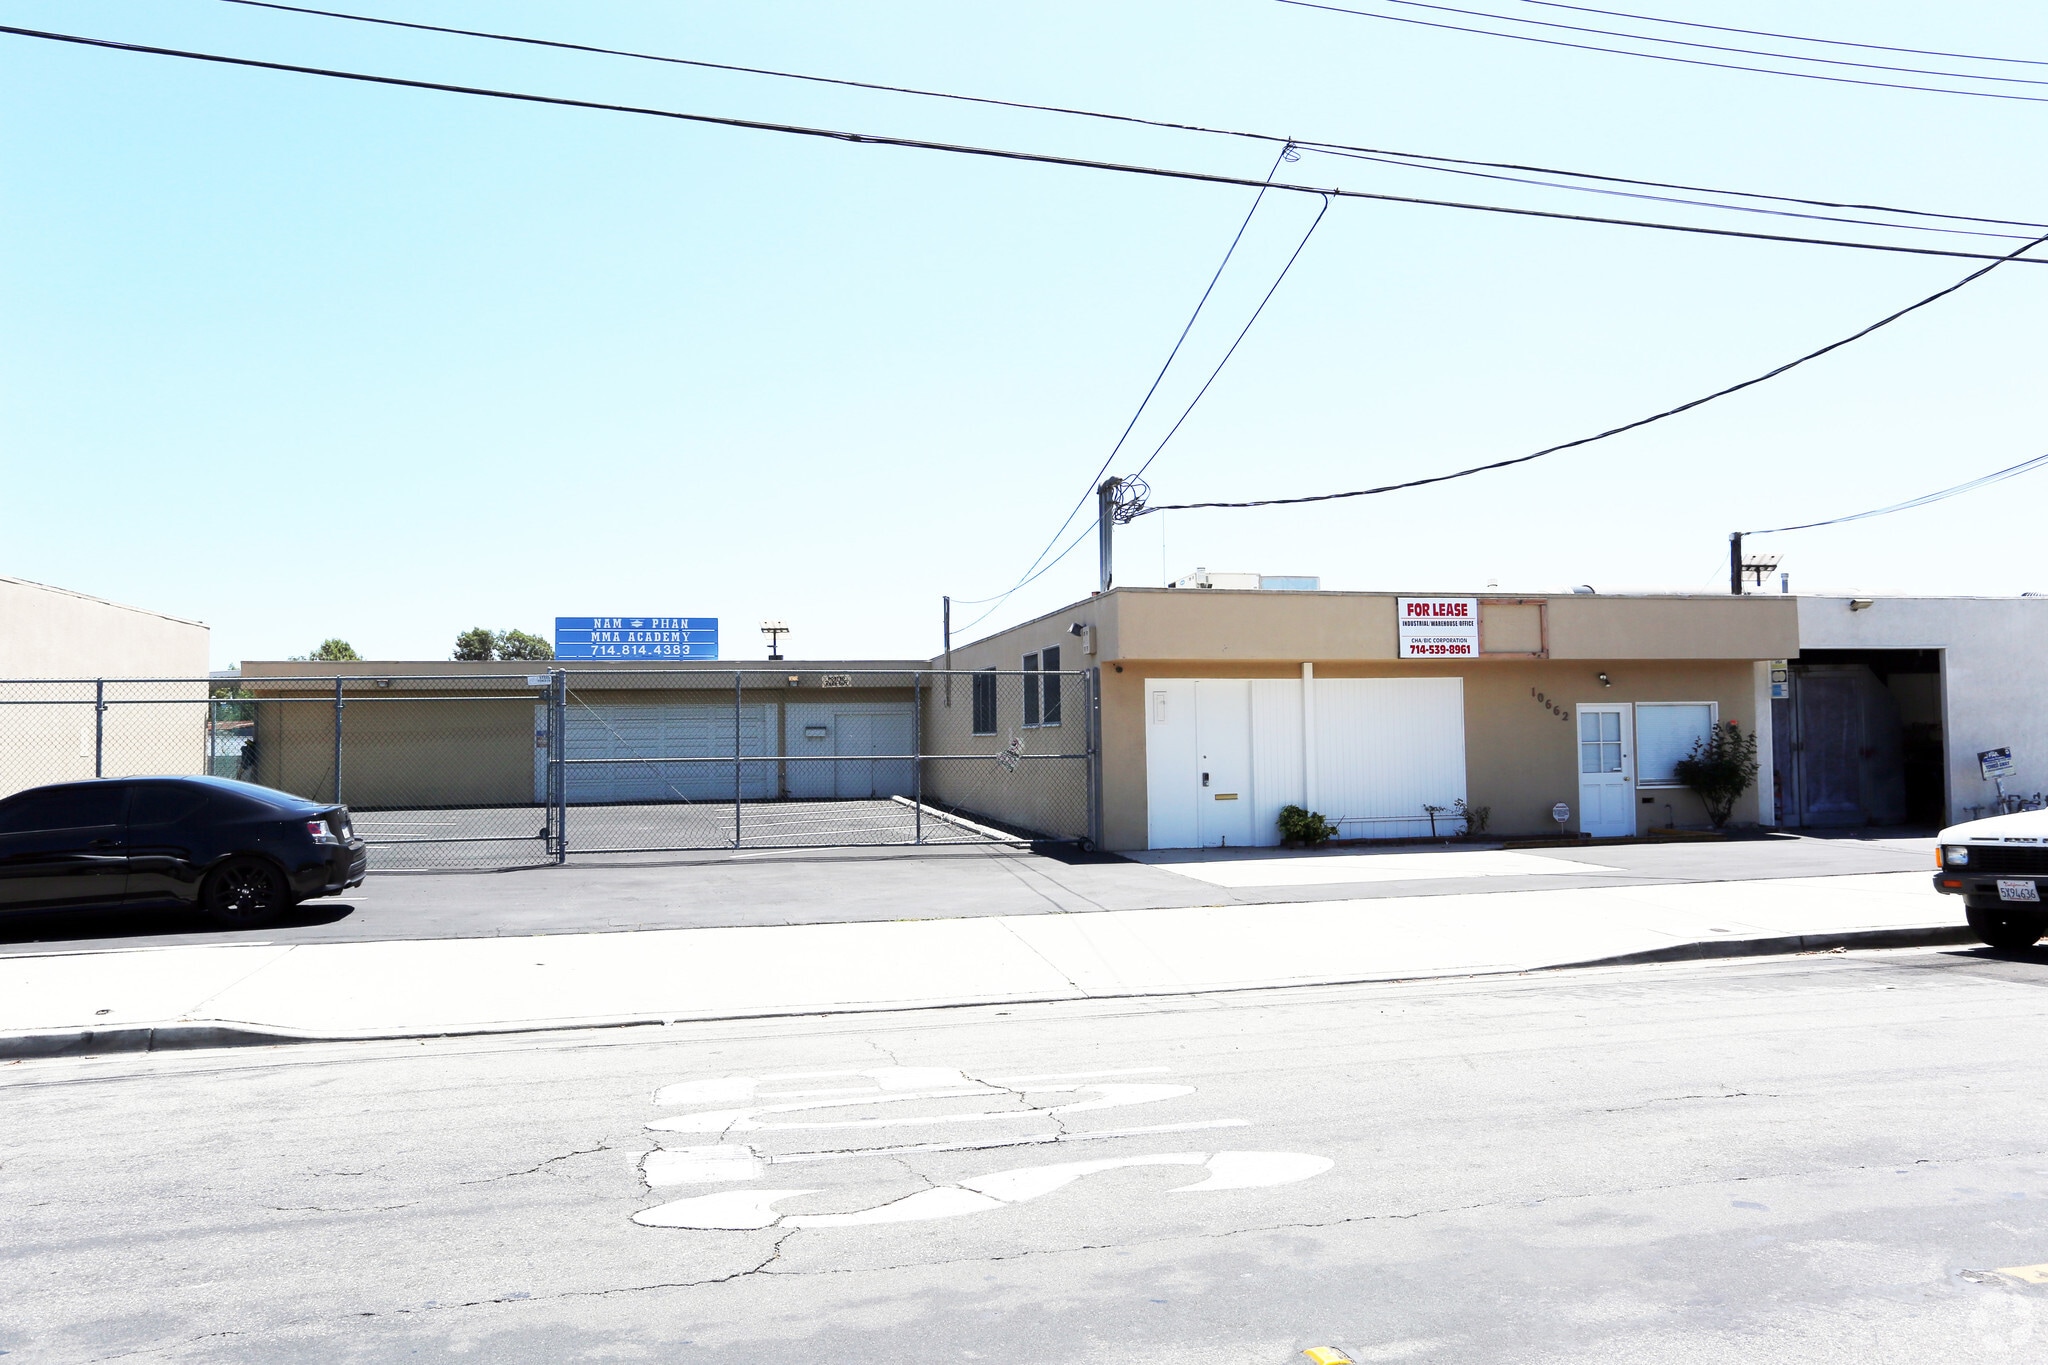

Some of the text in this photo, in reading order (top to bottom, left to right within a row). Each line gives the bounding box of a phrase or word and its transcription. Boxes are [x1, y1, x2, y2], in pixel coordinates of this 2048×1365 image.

[1407, 603, 1468, 616] FOR LEASE
[593, 619, 689, 629] NAM PHAN
[591, 632, 691, 642] MMA ACADEMY
[591, 645, 691, 655] 714.814.4383
[1410, 645, 1471, 654] 714-539-8961
[1531, 687, 1569, 721] 10662
[2000, 888, 2036, 899] 5X94636
